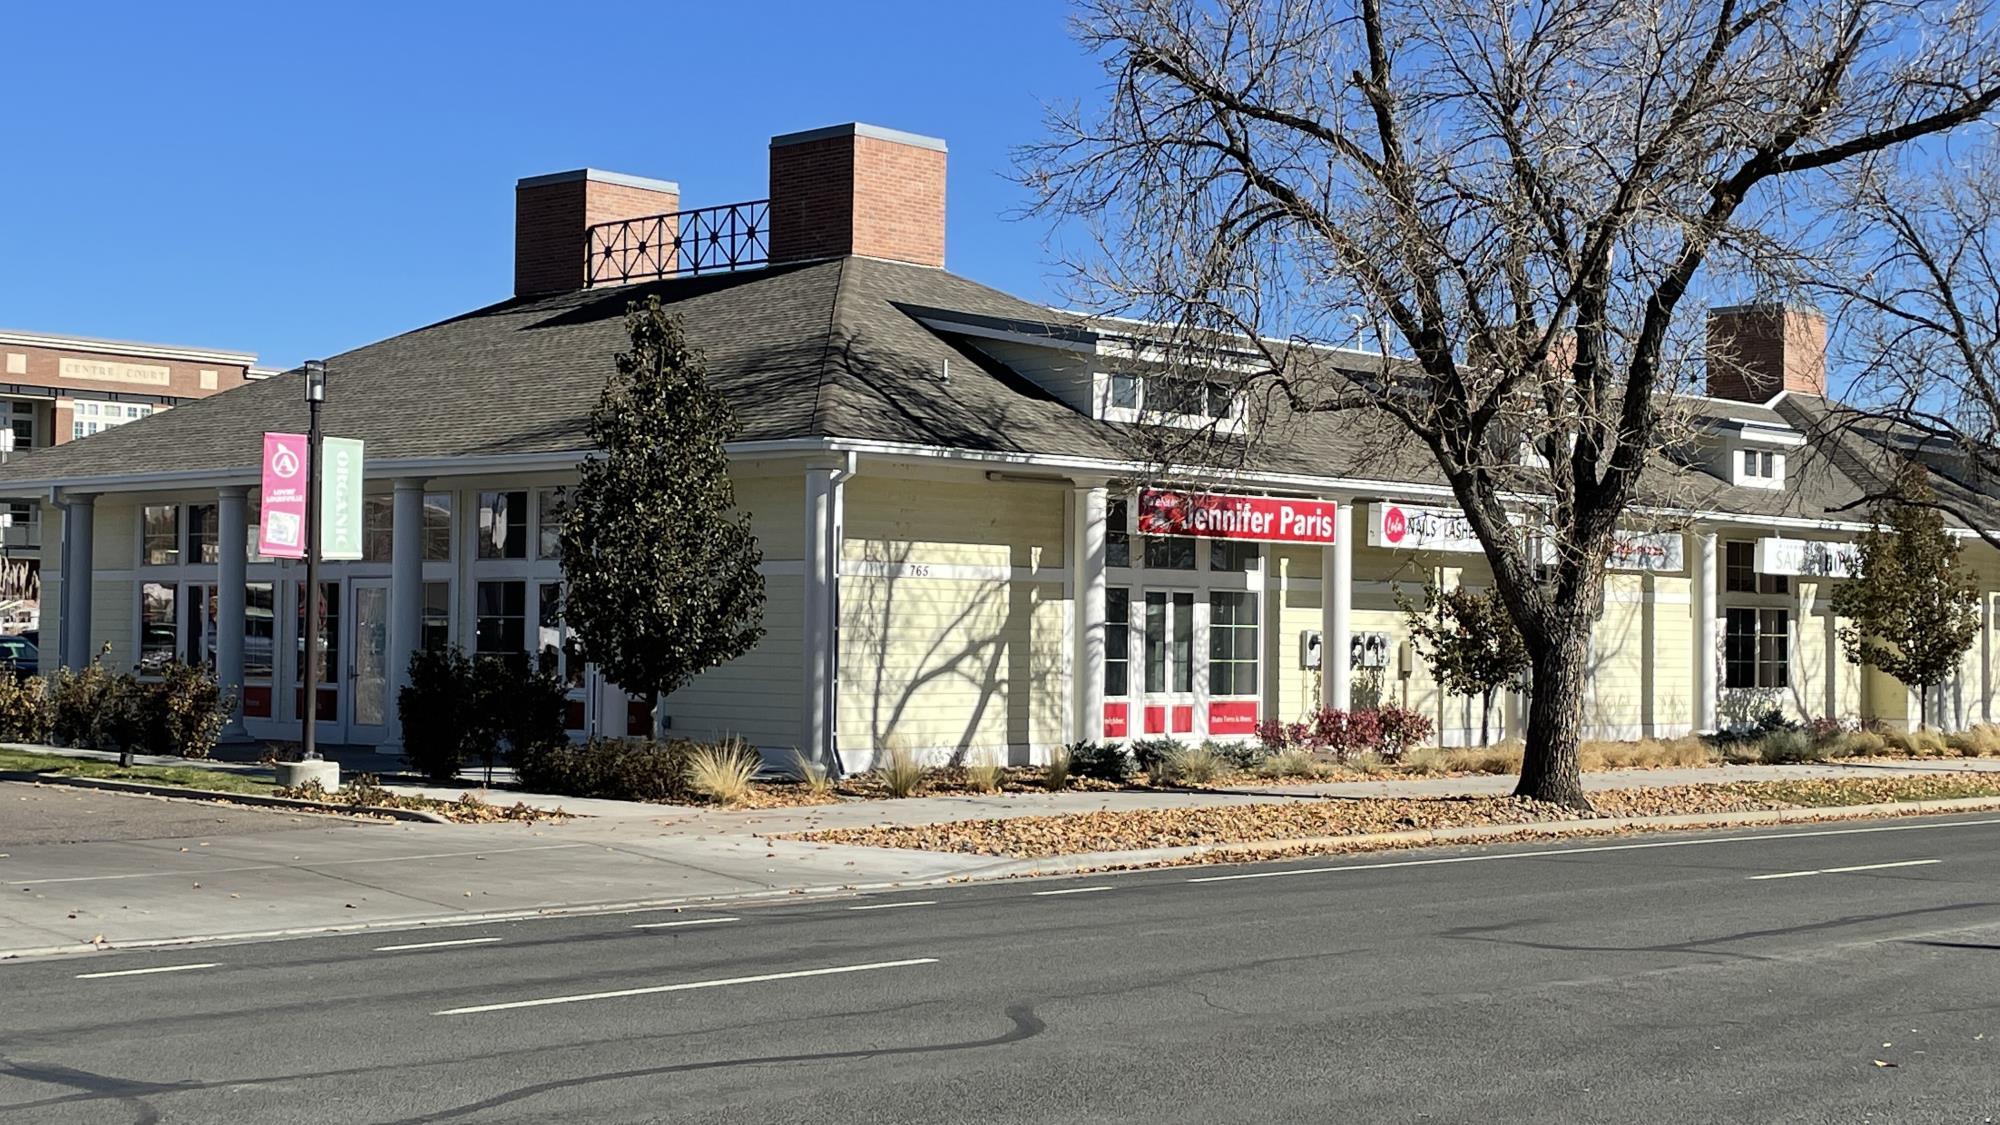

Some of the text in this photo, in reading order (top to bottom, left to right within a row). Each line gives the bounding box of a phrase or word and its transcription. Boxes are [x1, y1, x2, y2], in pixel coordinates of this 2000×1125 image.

[65, 363, 166, 381] CENTRE COURT
[335, 450, 350, 546] ORGANIC
[1183, 499, 1332, 537] Jennifer Paris
[1407, 517, 1436, 537] NAILS
[1444, 520, 1478, 540] LASHE
[910, 565, 929, 577] 765
